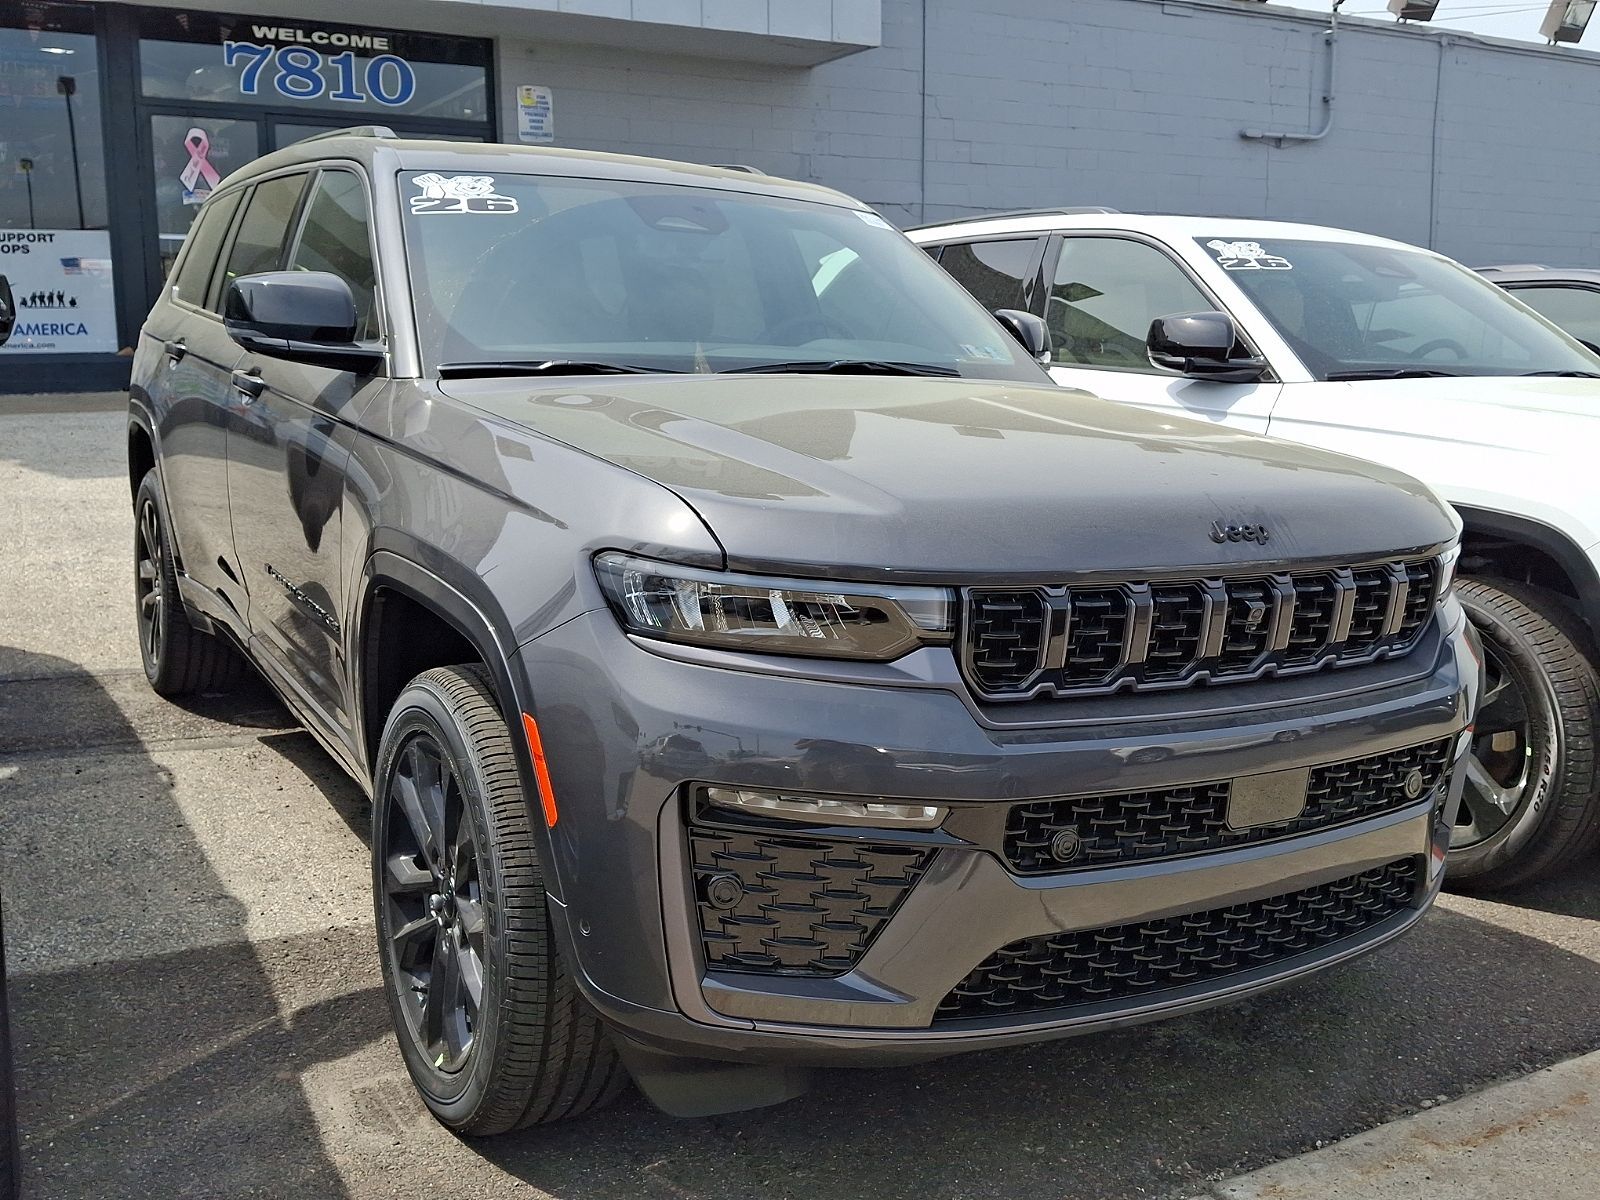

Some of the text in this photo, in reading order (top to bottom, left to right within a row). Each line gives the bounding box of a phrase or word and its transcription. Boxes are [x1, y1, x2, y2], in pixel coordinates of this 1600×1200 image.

[251, 24, 390, 50] WELCOME
[223, 40, 416, 107] 7810
[409, 195, 519, 215] 26
[1217, 255, 1293, 270] 26
[13, 322, 88, 336] AMERICA
[1208, 520, 1270, 545] Jeep
